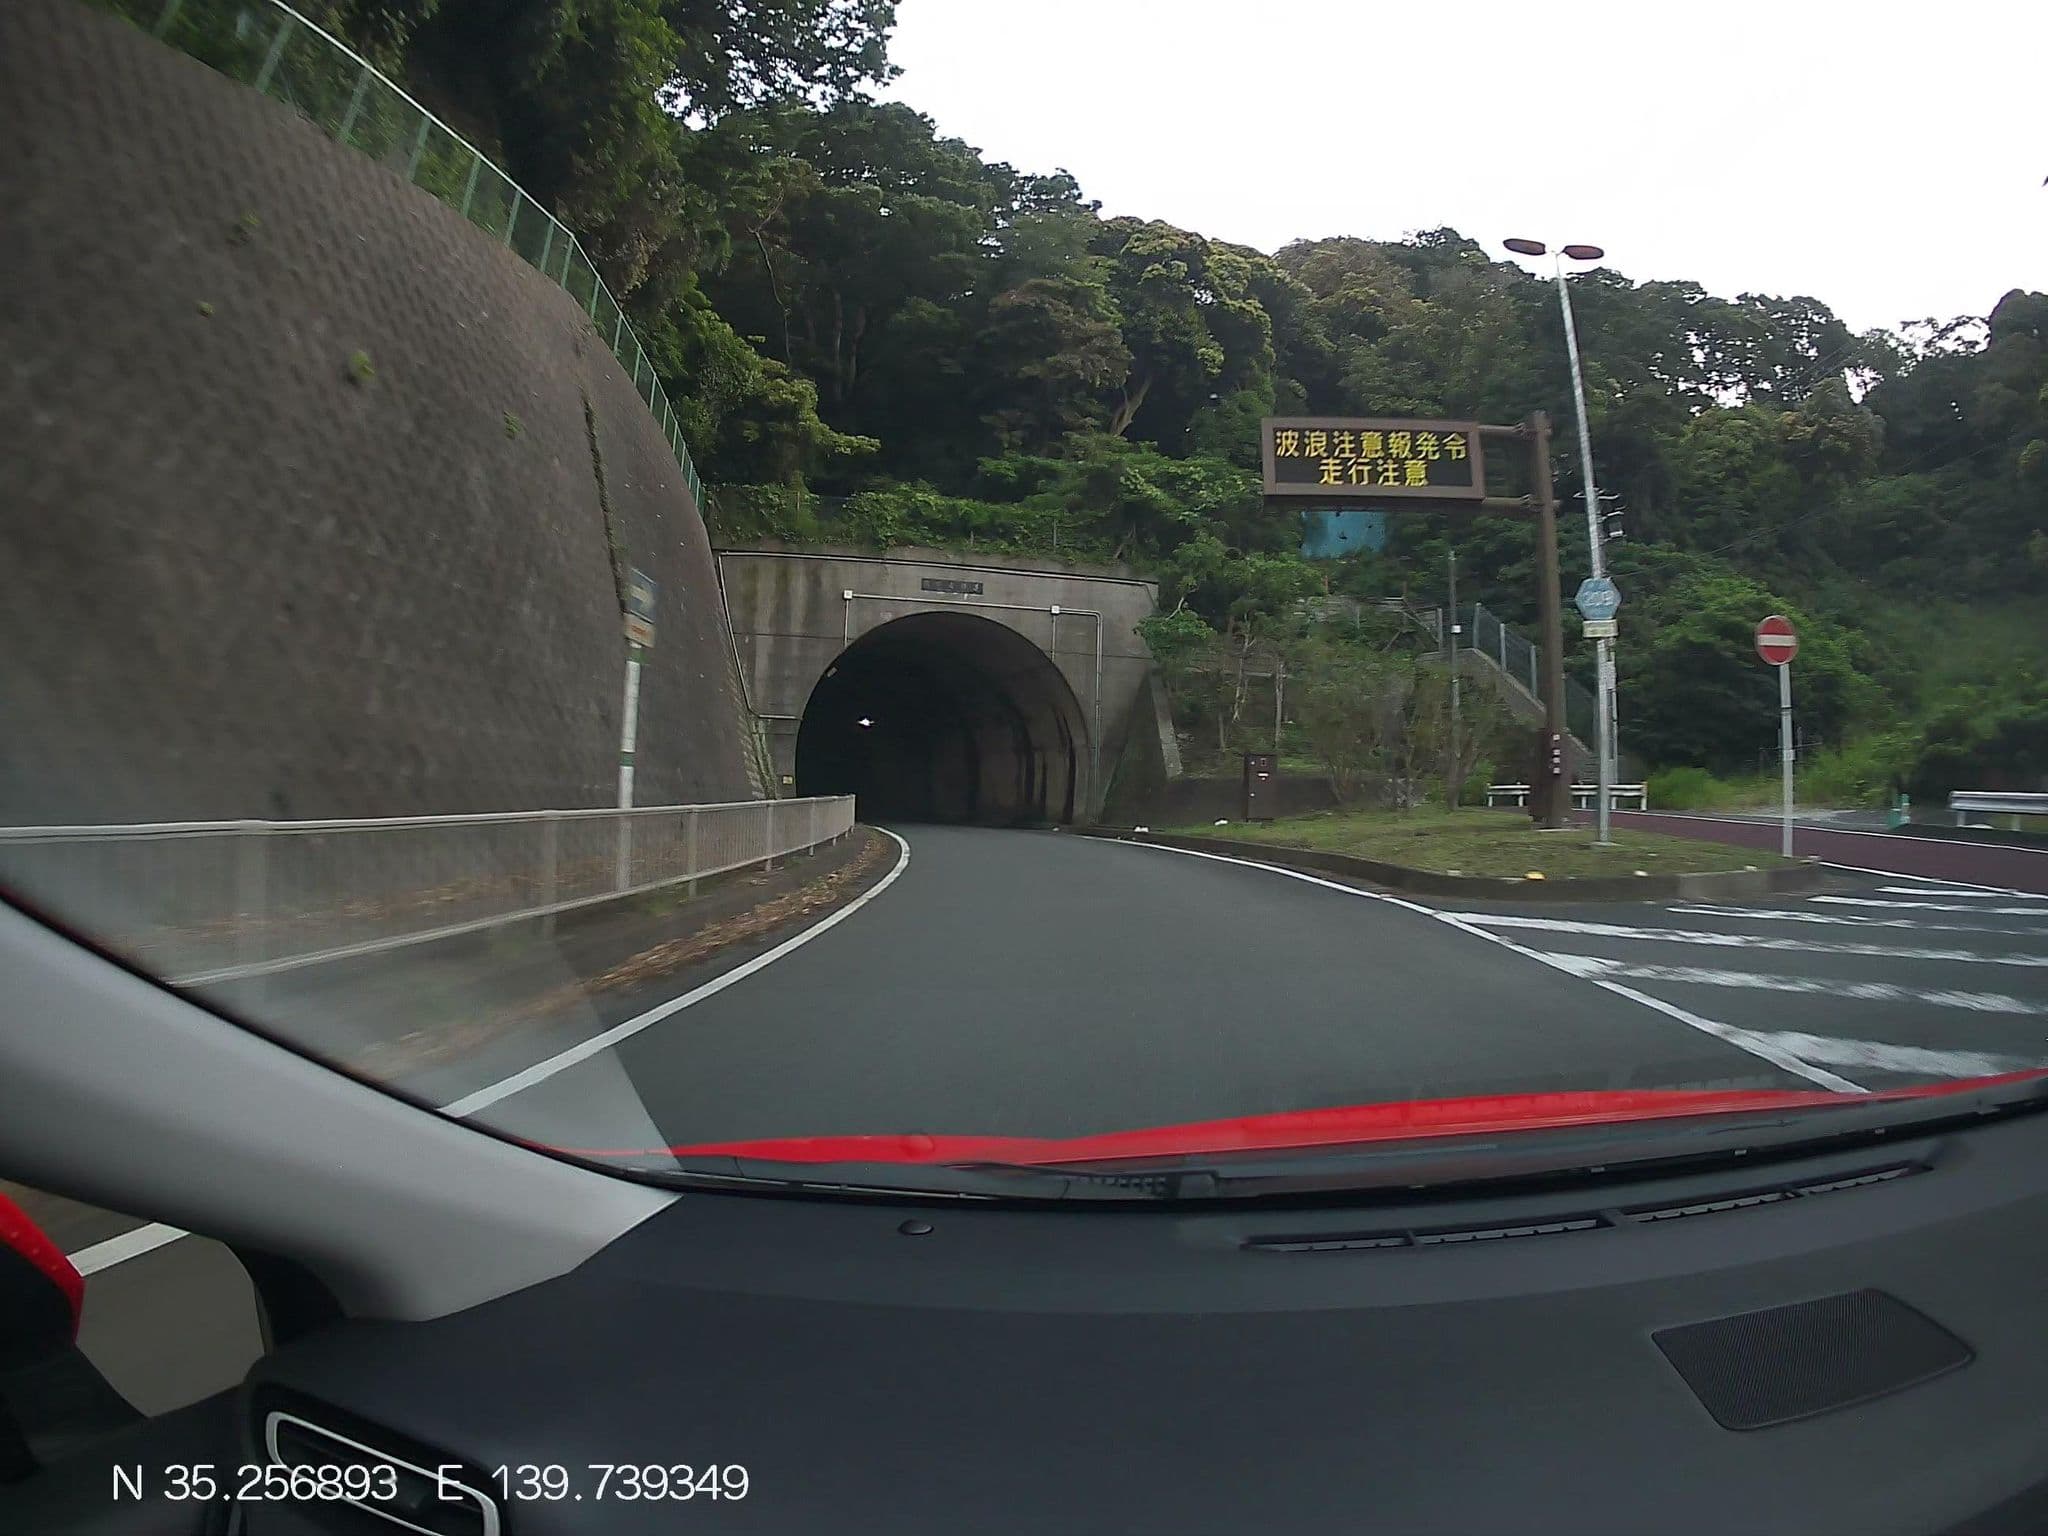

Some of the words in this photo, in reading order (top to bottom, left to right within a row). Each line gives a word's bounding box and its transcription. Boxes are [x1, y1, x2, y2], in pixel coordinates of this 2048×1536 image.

[1276, 430, 1467, 460] 波浪注意報発令
[1319, 458, 1429, 487] 走行注意
